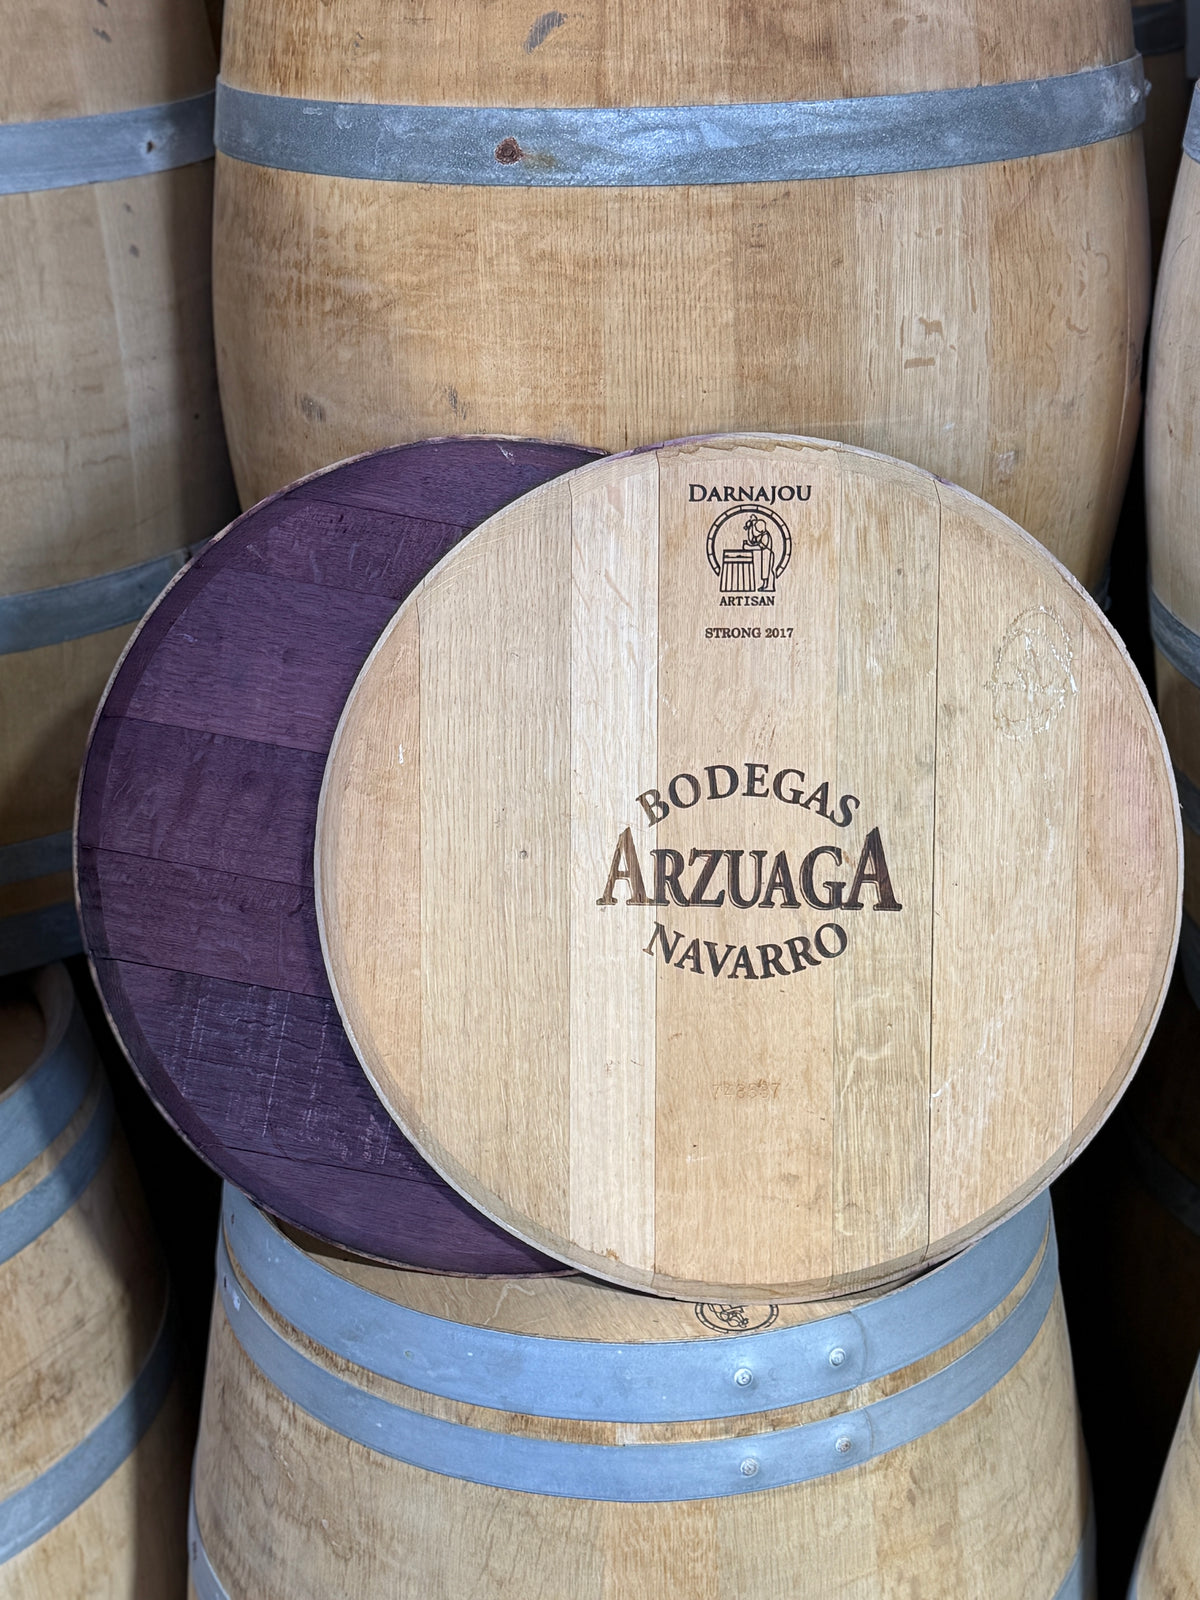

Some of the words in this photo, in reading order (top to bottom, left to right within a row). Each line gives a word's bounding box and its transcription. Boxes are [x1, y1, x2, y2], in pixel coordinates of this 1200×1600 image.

[688, 484, 812, 505] DARNAJOU
[719, 596, 776, 606] ARTISAN
[705, 627, 762, 639] STRONG
[765, 627, 794, 639] 2017
[635, 762, 860, 827] BODEGAS
[596, 826, 903, 911] ARZUAGA
[643, 921, 848, 980] NAVARRO
